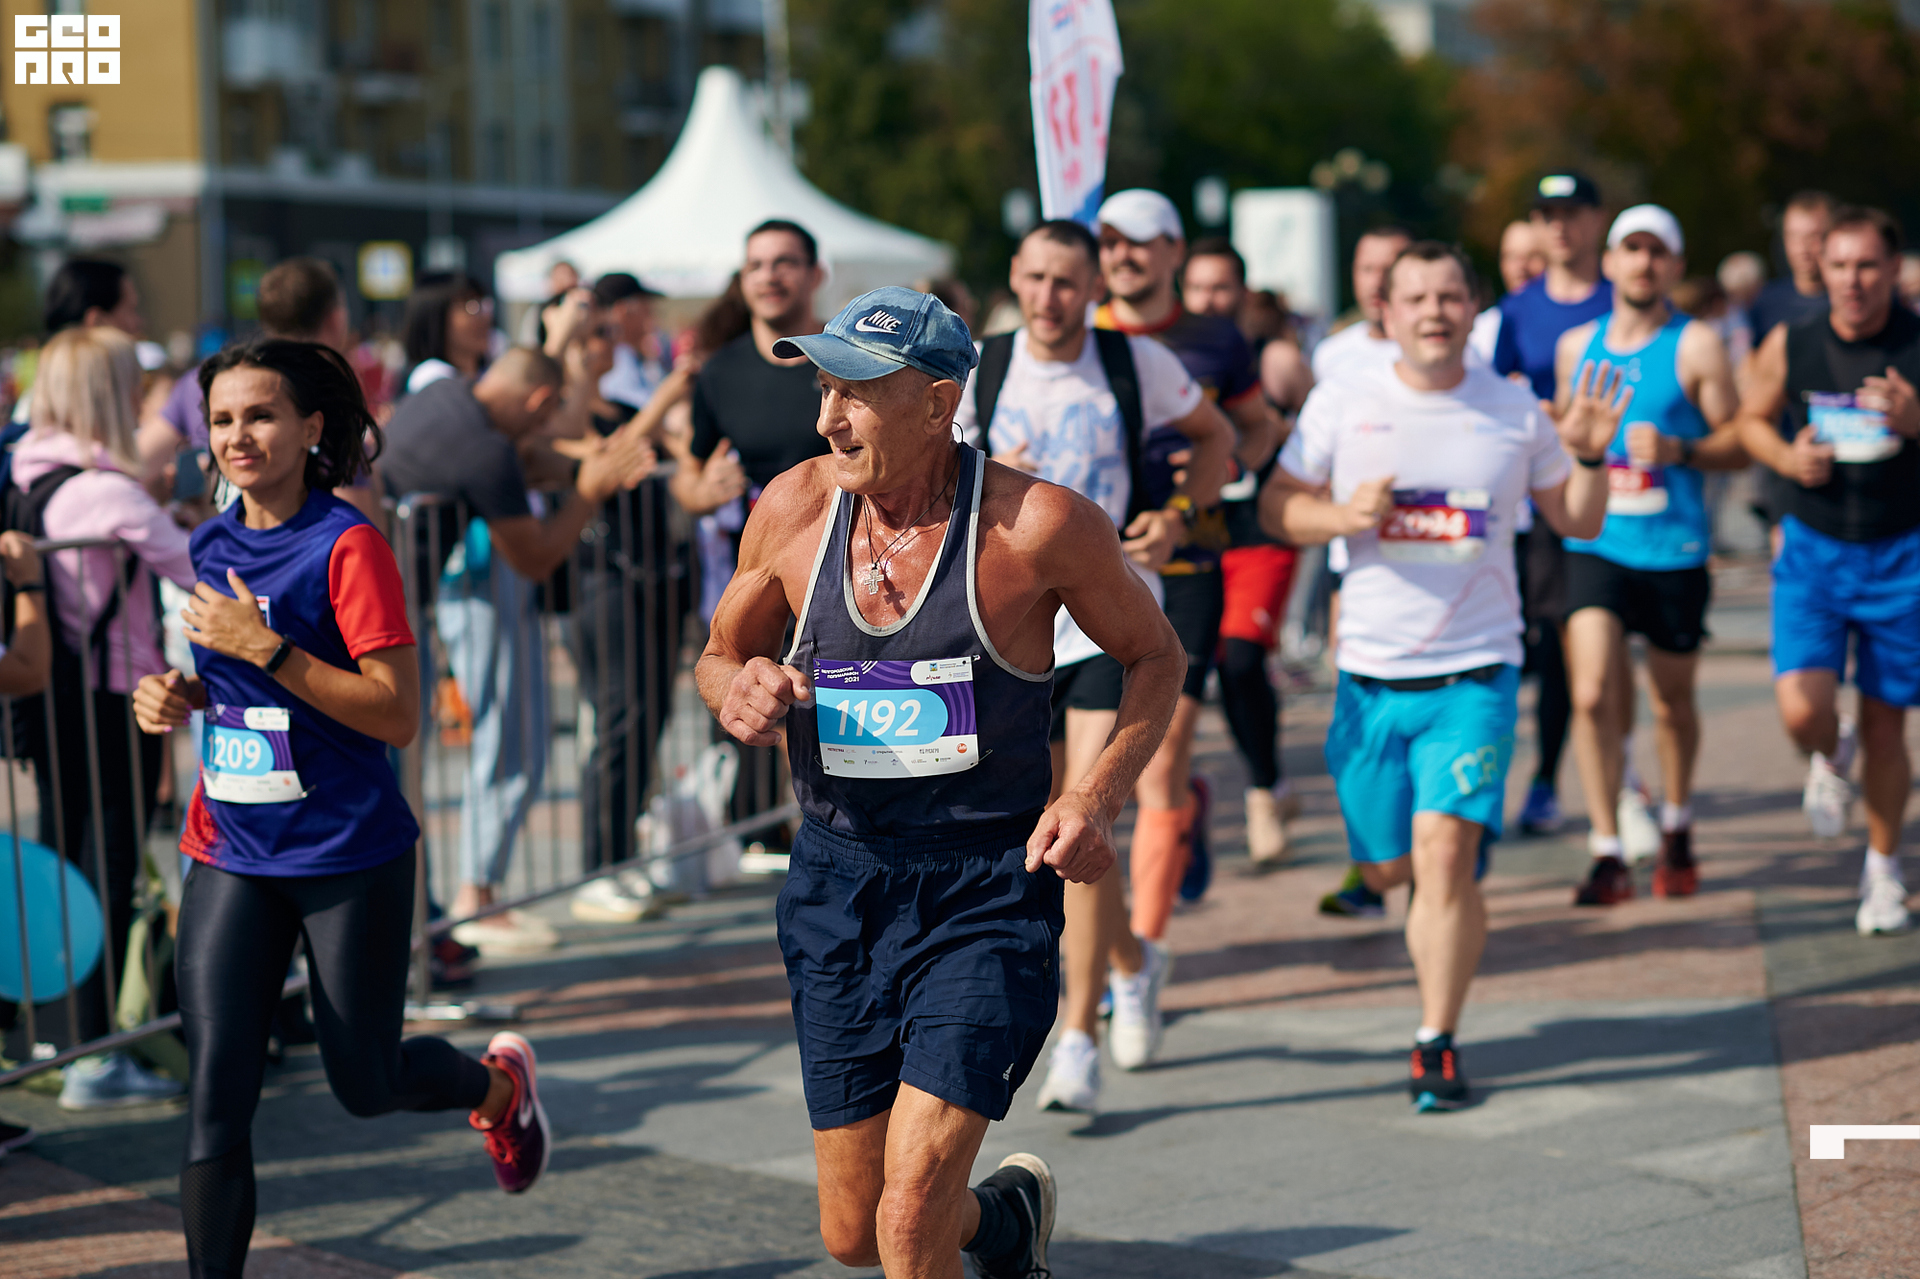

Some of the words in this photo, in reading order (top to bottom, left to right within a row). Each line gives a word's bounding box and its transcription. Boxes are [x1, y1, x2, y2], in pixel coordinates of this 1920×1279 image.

[868, 310, 902, 331] NIKE
[844, 676, 860, 684] 2021
[836, 699, 921, 737] 1192
[208, 734, 261, 770] 1209
